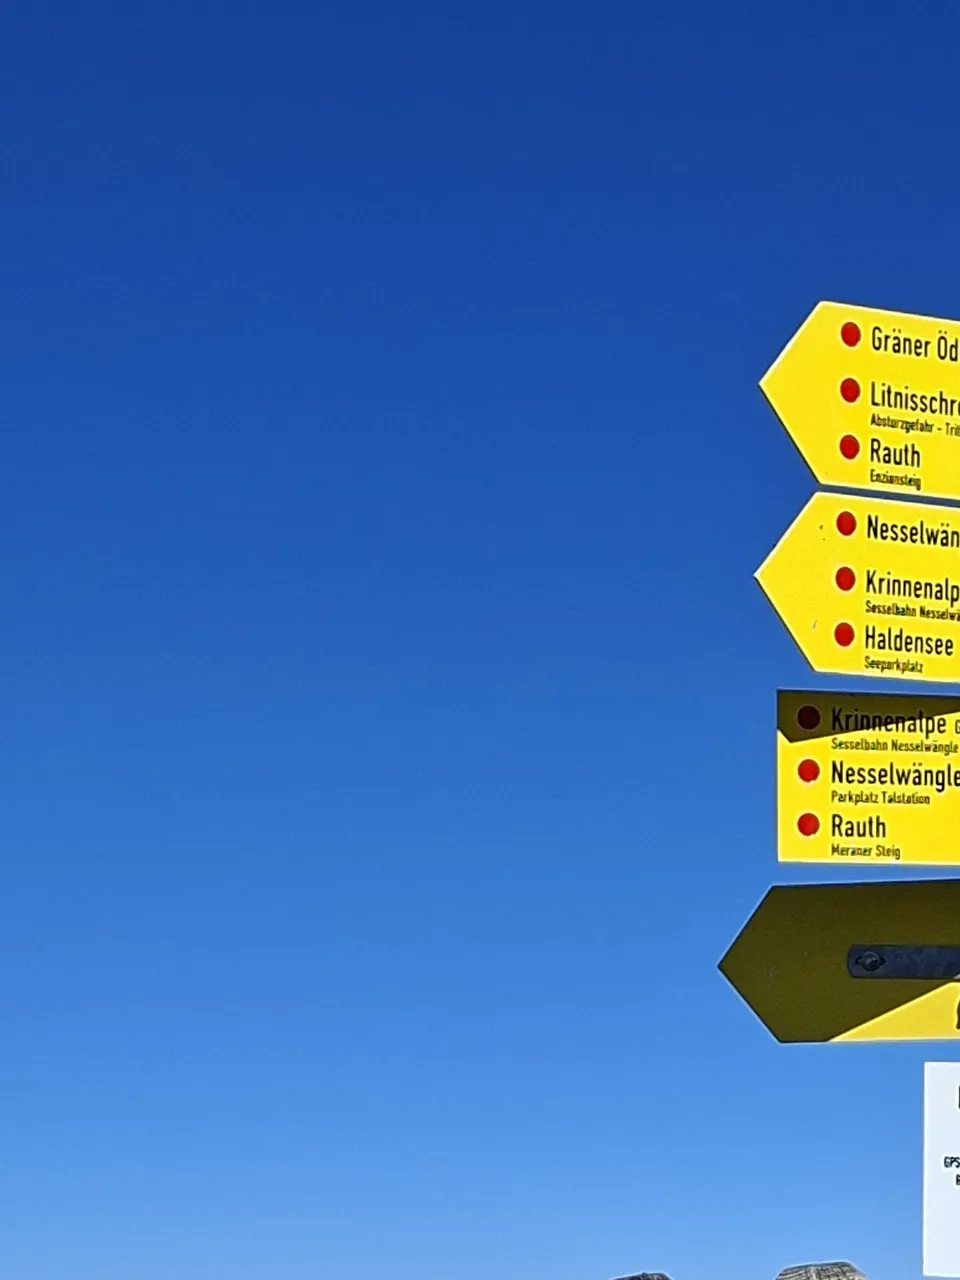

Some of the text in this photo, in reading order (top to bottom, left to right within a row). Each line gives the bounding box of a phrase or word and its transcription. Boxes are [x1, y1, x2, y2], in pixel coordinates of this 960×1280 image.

[871, 326, 932, 358] Gräner
[870, 413, 934, 433] Absturzgefahr
[870, 437, 921, 468] Rauth
[865, 600, 917, 617] Sesselbahn
[865, 625, 954, 656] Haldensee
[864, 655, 924, 674] Seeparkplatz
[831, 706, 947, 740] Krinnenalpe
[831, 737, 959, 756] Sesselbahn Nesselwängle
[831, 791, 931, 807] Parkplatz Talstation
[831, 813, 887, 839] Rauth
[831, 844, 901, 860] Meraner Steig
